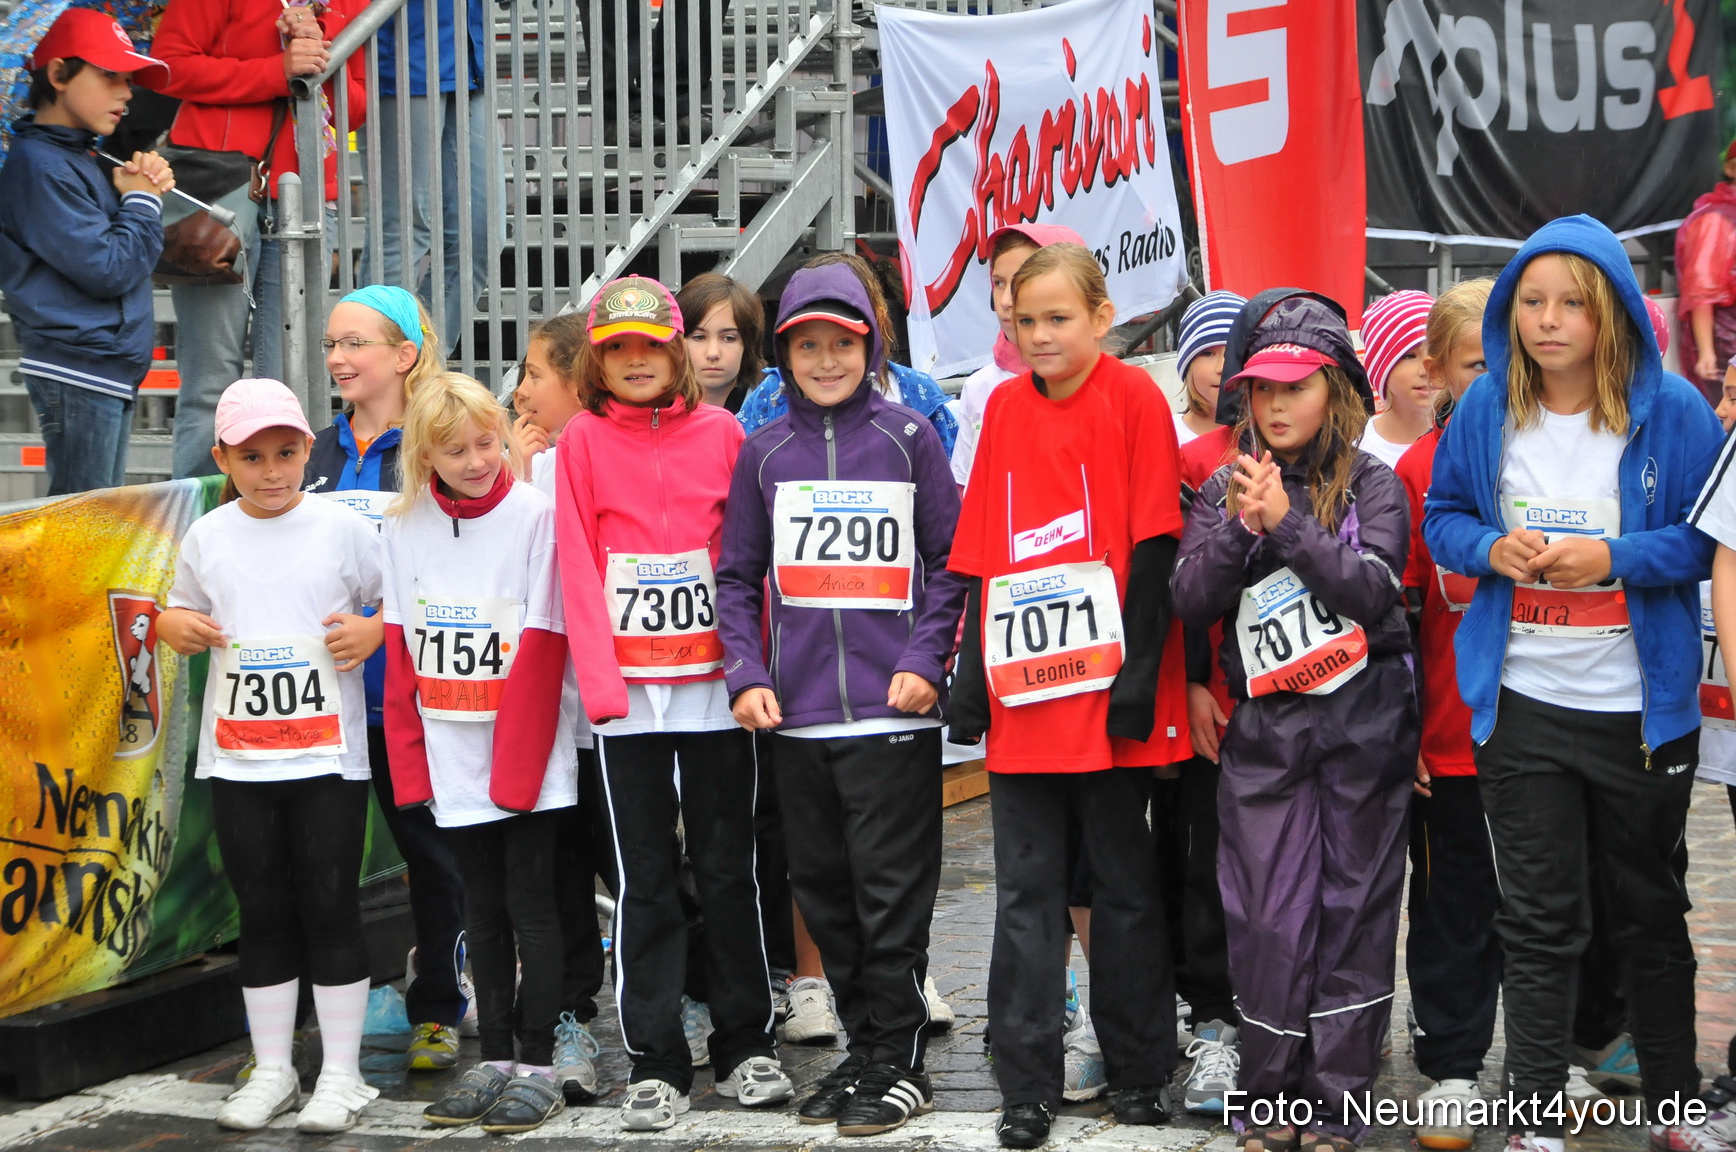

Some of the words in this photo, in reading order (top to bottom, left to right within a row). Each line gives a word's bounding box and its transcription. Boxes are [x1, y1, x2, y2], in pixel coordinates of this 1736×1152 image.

[898, 14, 1155, 317] Charivari
[1118, 217, 1175, 274] Radio
[813, 491, 872, 504] BOCK
[1527, 508, 1588, 525] BOCK
[790, 516, 899, 562] 7290
[1034, 525, 1063, 547] DEHN
[637, 561, 688, 576] BOCK
[818, 574, 865, 591] Anica
[1010, 574, 1066, 597] BOCK
[426, 605, 476, 619] BOCK
[617, 583, 714, 632] 7303
[1512, 603, 1570, 625] aura
[994, 595, 1099, 658] 7071
[1248, 595, 1343, 669] 7079
[240, 646, 294, 662] BOCK
[415, 628, 503, 676] 7154
[651, 638, 692, 660] Eva
[1023, 658, 1086, 686] Leonie
[226, 669, 325, 716] 7304
[426, 678, 489, 711] ARAH
